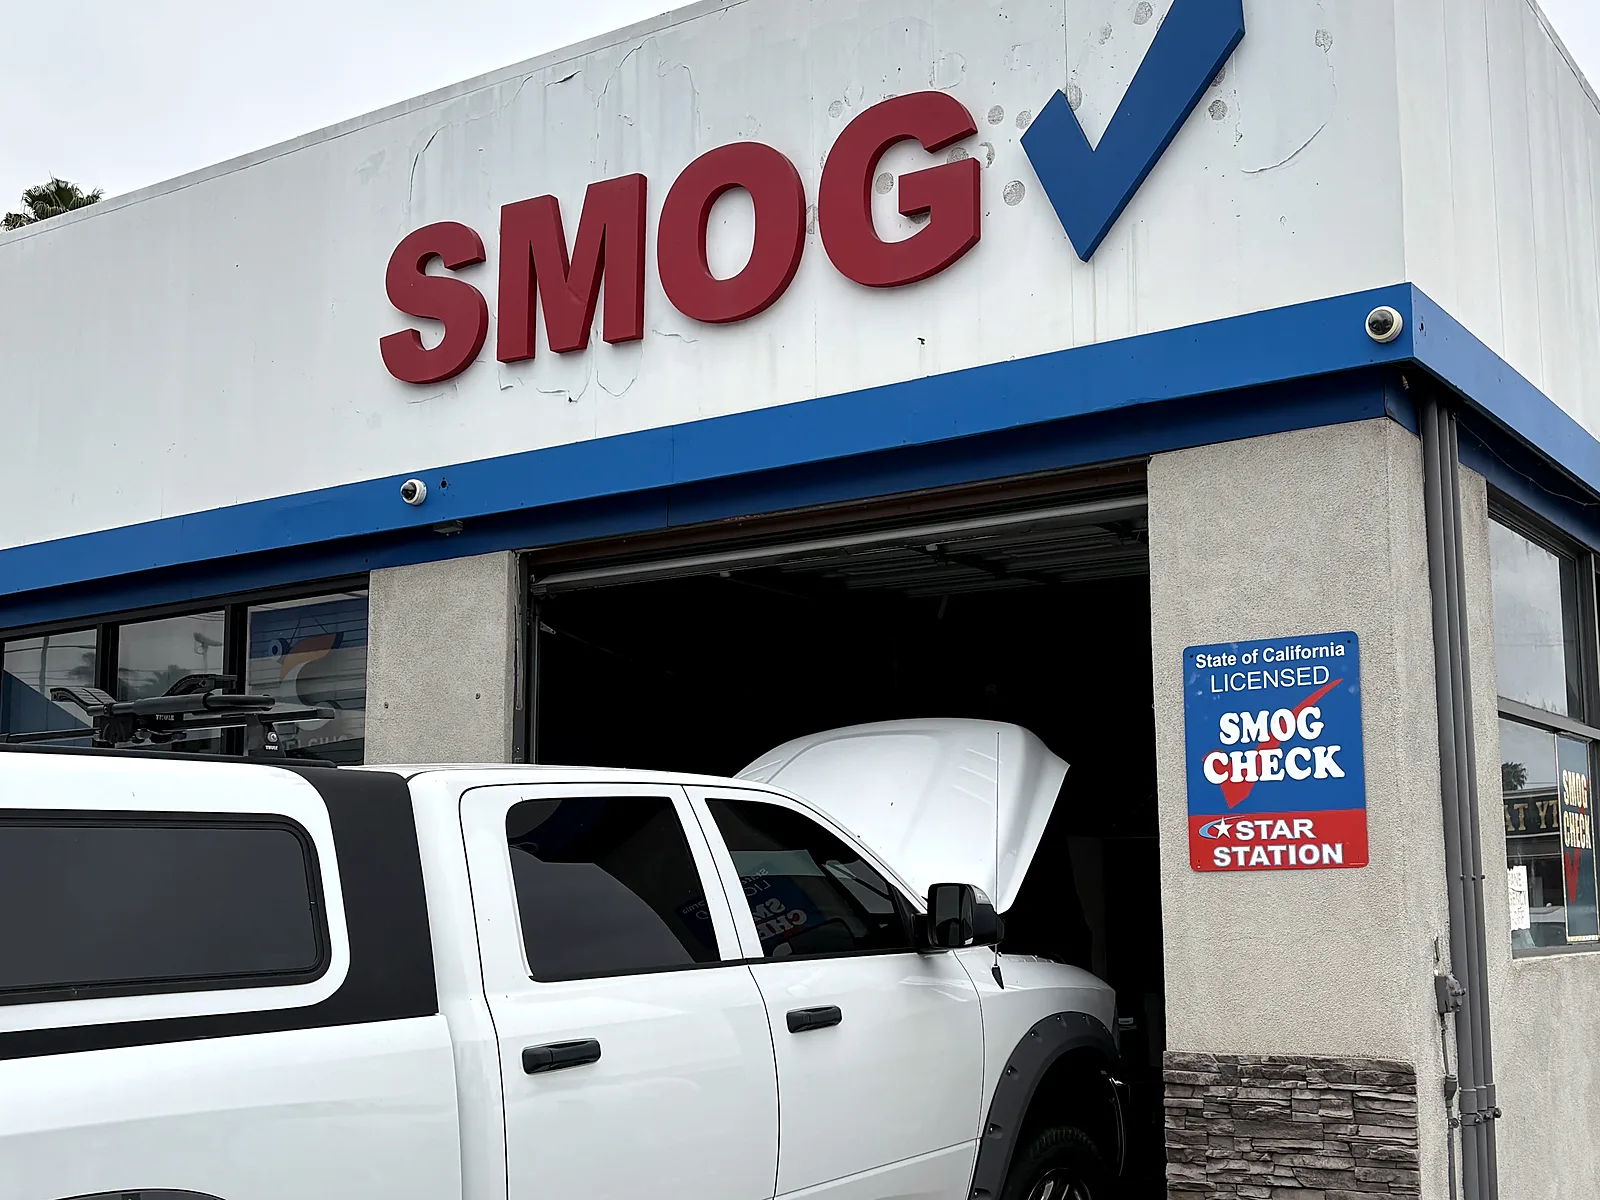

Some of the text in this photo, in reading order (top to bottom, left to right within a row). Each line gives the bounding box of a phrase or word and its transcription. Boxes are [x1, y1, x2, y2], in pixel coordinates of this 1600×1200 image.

[379, 90, 981, 385] SMOG
[1195, 642, 1345, 669] State of California
[1210, 665, 1330, 693] LICENSED
[1219, 706, 1325, 745] SMOG
[1203, 745, 1345, 785] CHECK
[1562, 769, 1588, 809] SMOG
[1235, 818, 1317, 841] STAR
[1563, 810, 1592, 849] CHECK
[1213, 843, 1344, 867] STATION
